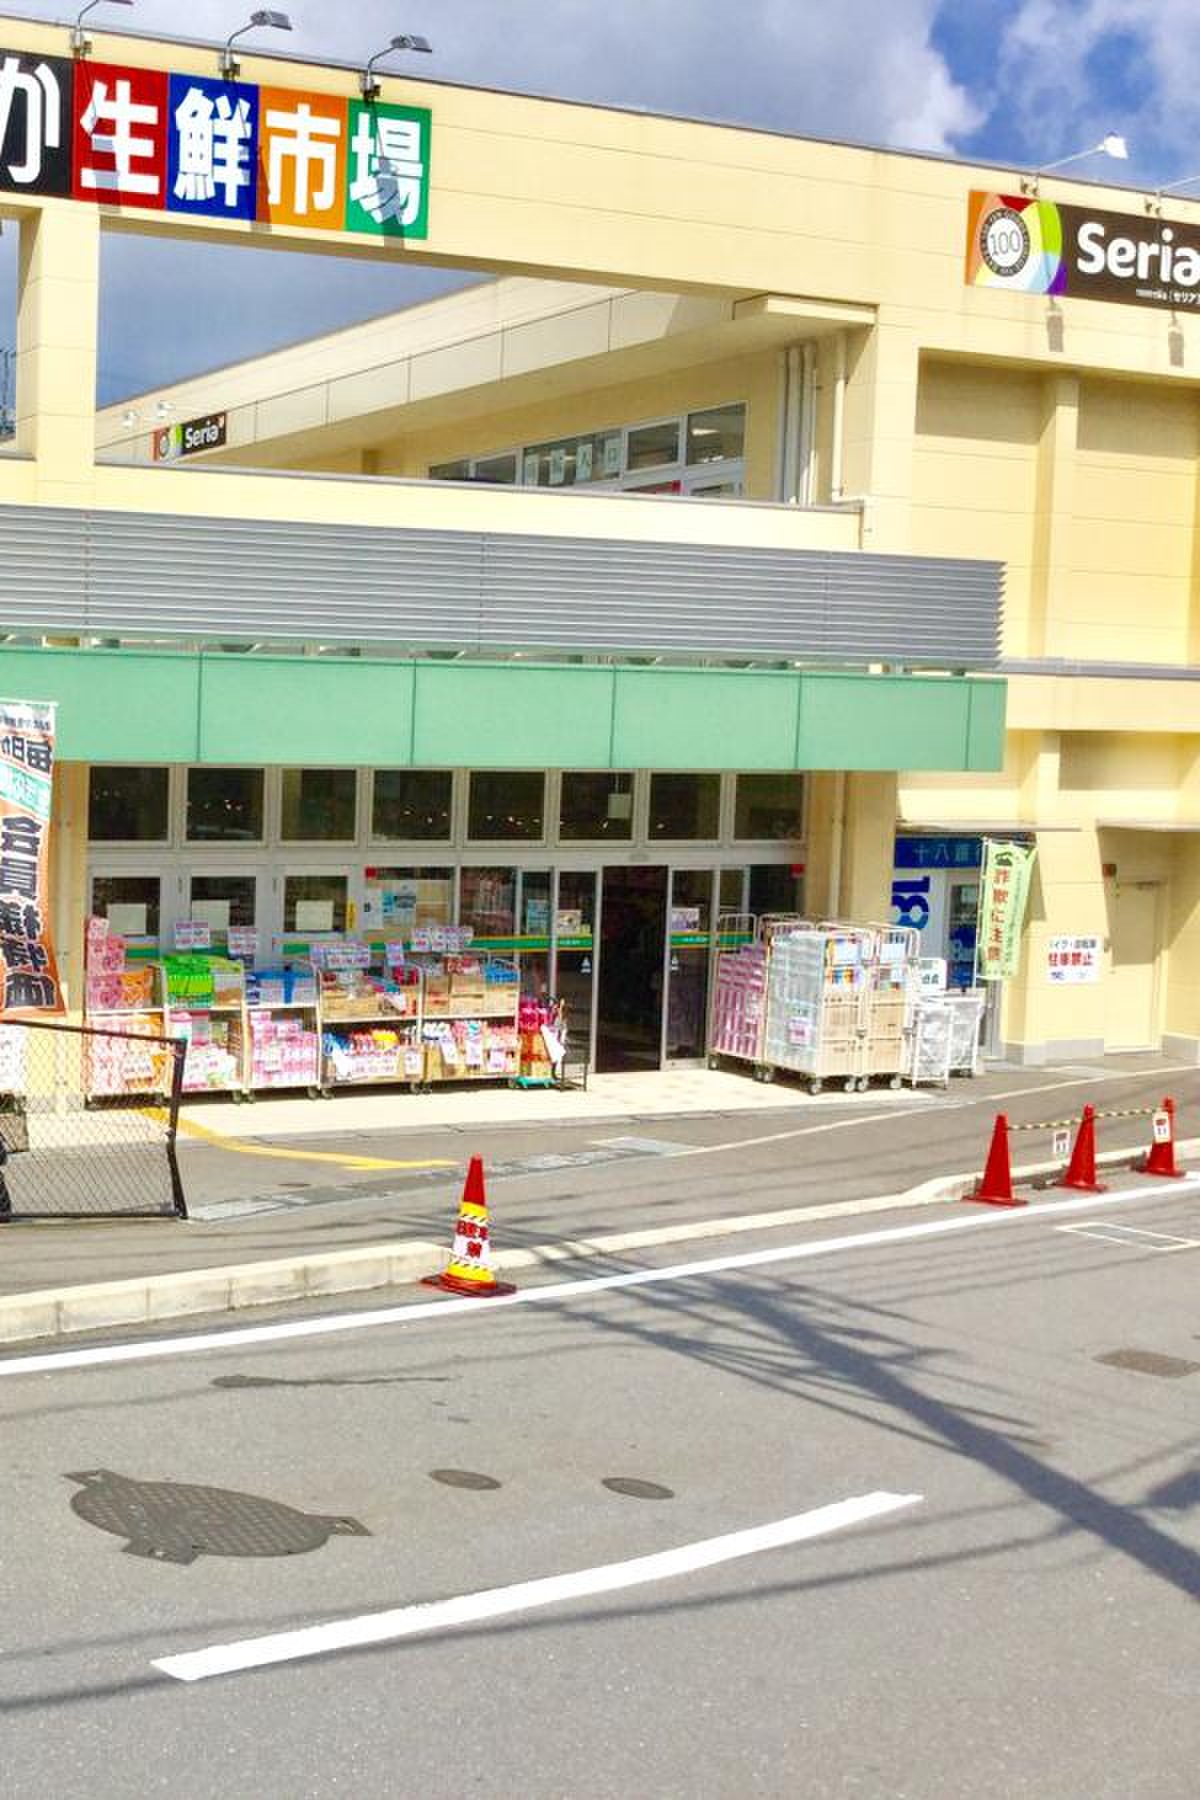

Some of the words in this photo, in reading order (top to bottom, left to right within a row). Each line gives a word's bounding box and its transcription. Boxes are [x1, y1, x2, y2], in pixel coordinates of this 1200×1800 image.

[989, 229, 1021, 256] 100
[1077, 221, 1200, 287] Seria
[185, 420, 219, 449] Seria
